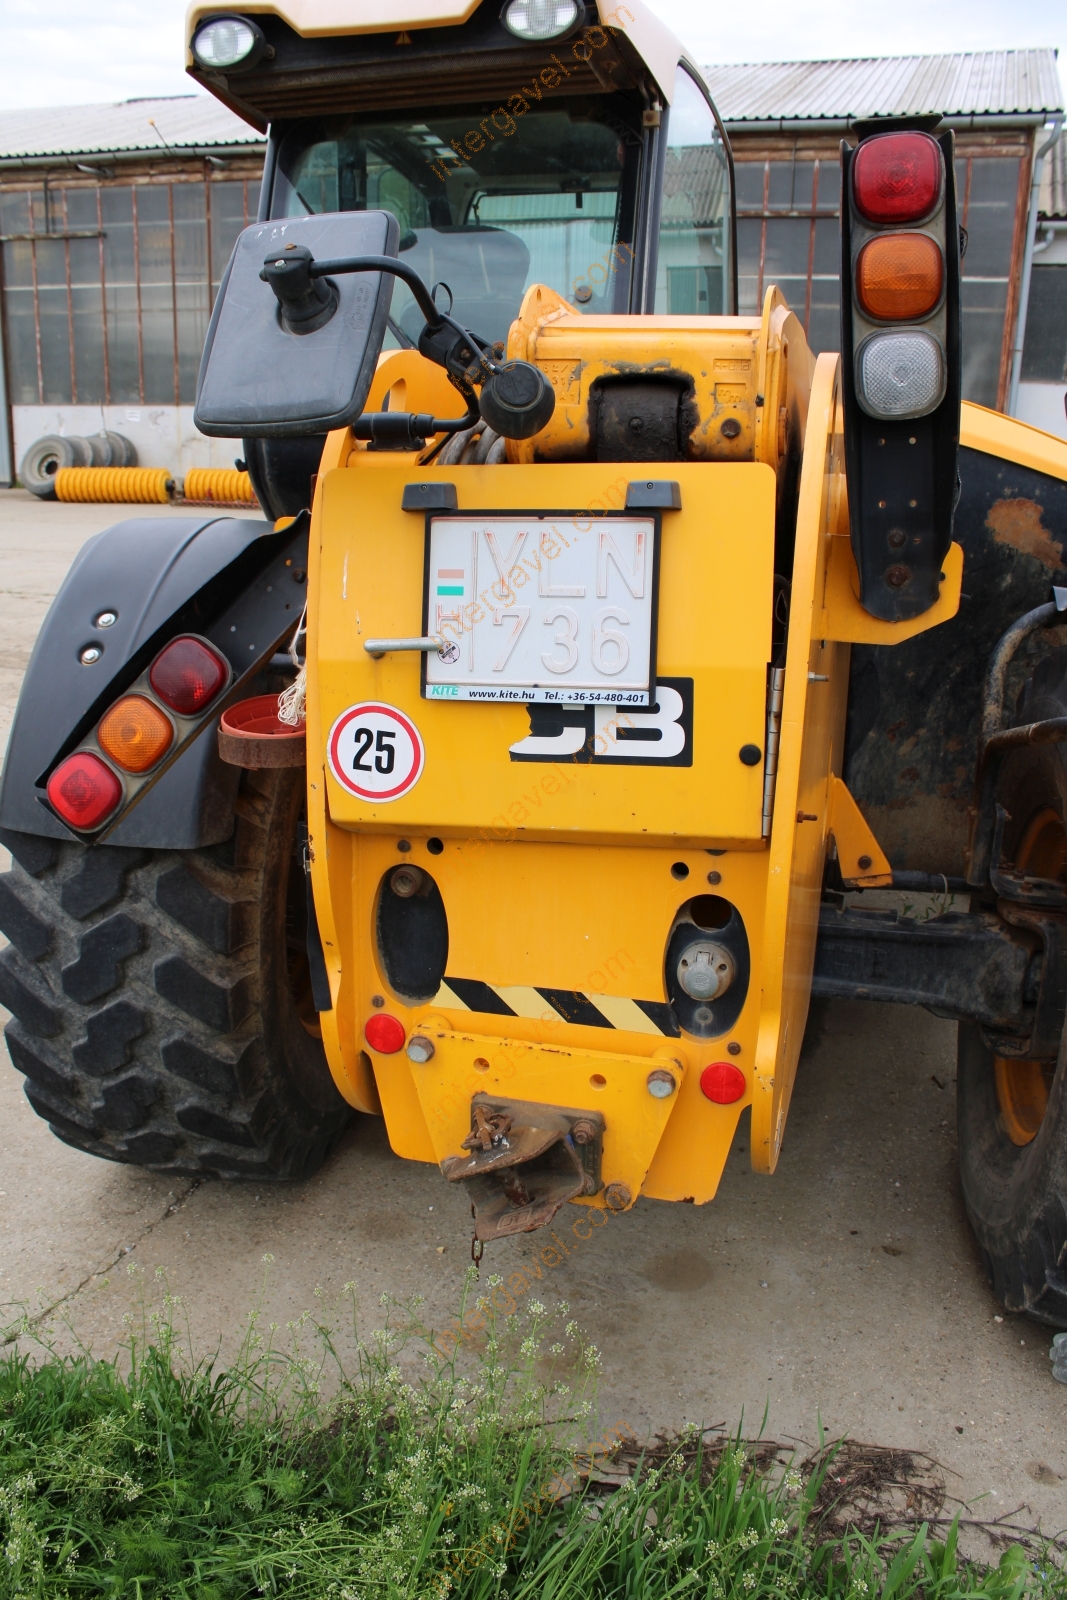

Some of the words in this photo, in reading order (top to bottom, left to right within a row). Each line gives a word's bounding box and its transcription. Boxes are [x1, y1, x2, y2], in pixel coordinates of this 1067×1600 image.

[435, 603, 464, 633] H
[492, 605, 630, 675] 736
[431, 685, 459, 696] KITE
[469, 690, 535, 699] www.kite.hu
[544, 691, 565, 700] Tel.:
[567, 692, 645, 703] +36-54-480-401
[352, 727, 396, 775] 25
